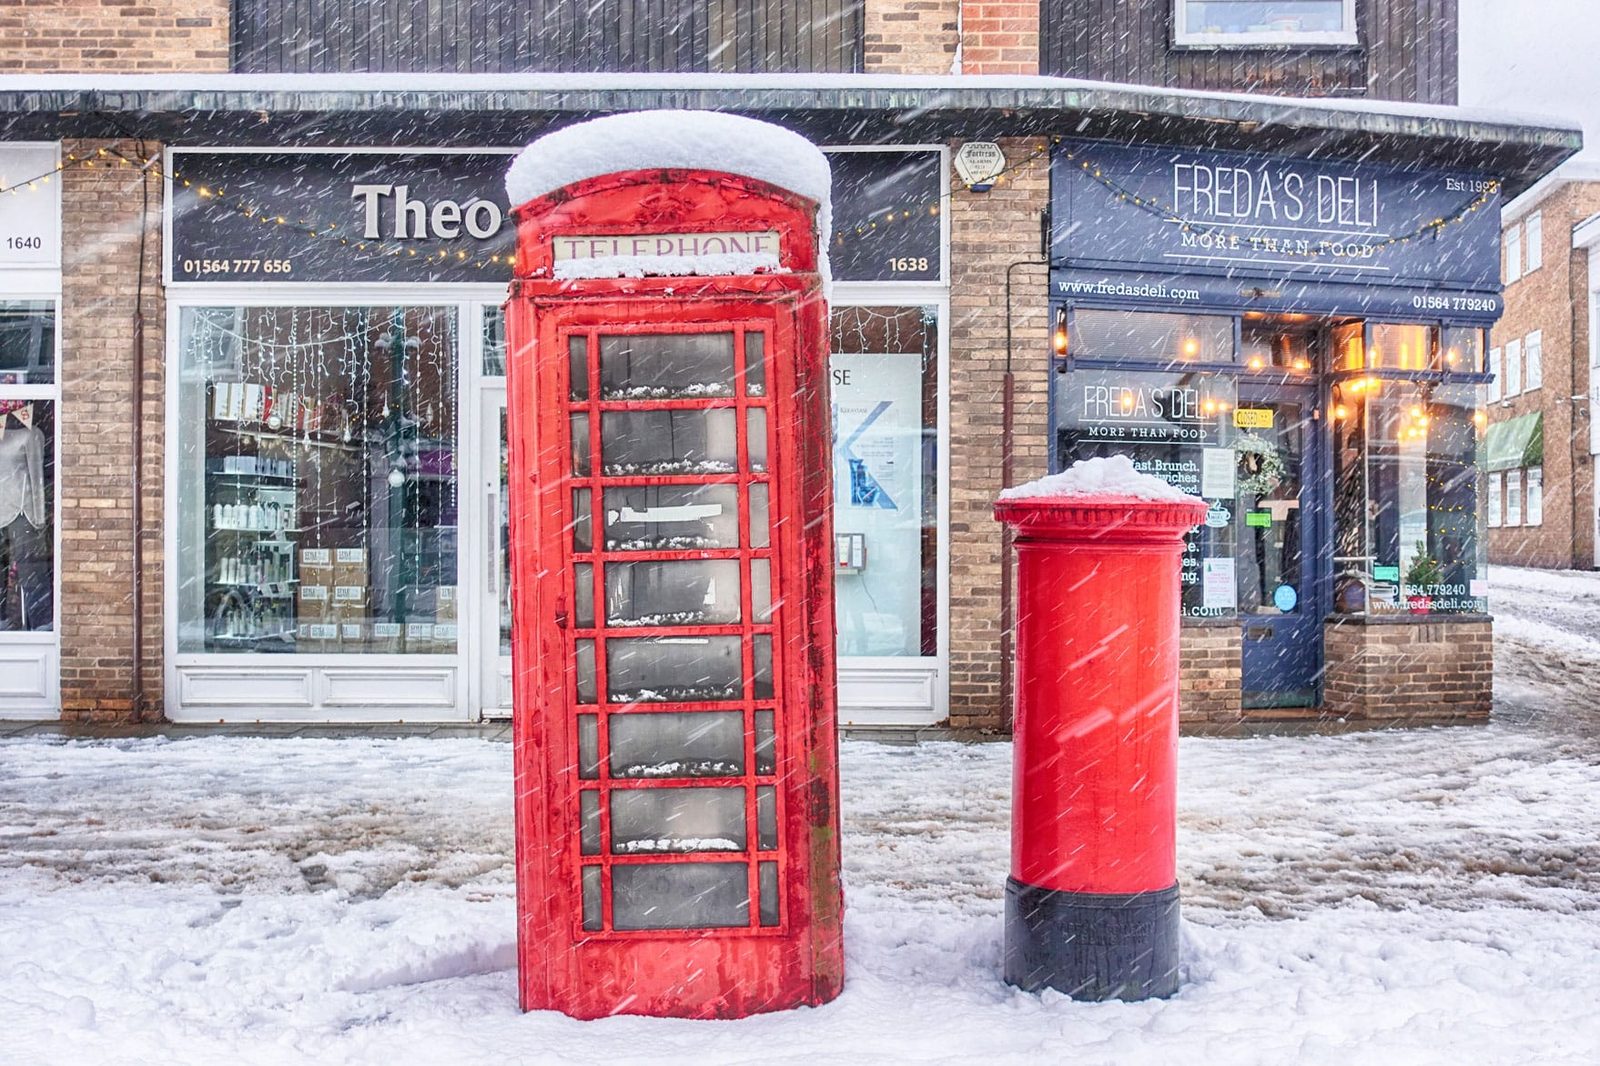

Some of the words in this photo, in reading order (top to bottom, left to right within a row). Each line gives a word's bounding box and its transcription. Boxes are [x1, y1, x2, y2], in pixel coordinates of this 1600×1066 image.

[1446, 178, 1465, 192] Est
[1174, 163, 1304, 221] FREDA'S
[1317, 175, 1377, 227] DELI
[351, 184, 502, 240] Theo
[6, 236, 42, 250] 1640
[1181, 232, 1240, 250] MORE
[1250, 236, 1309, 254] THAN
[1318, 241, 1375, 258] FOOD
[184, 259, 230, 273] 01564
[233, 259, 261, 273] 777
[263, 259, 292, 273] 656
[889, 257, 928, 272] 1638
[1058, 280, 1200, 300] www.fredasdeli.com
[1412, 295, 1450, 310] 01564
[1452, 297, 1496, 312] 779240
[1084, 385, 1164, 418] FREDA'S
[1171, 388, 1210, 420] DELI
[1088, 426, 1125, 437] MORE
[1130, 427, 1167, 438] THAN
[1172, 429, 1208, 439] FOOD
[1392, 584, 1424, 596] 0564
[1427, 584, 1466, 596] 779240
[1371, 598, 1484, 610] www.fredasdeli.com
